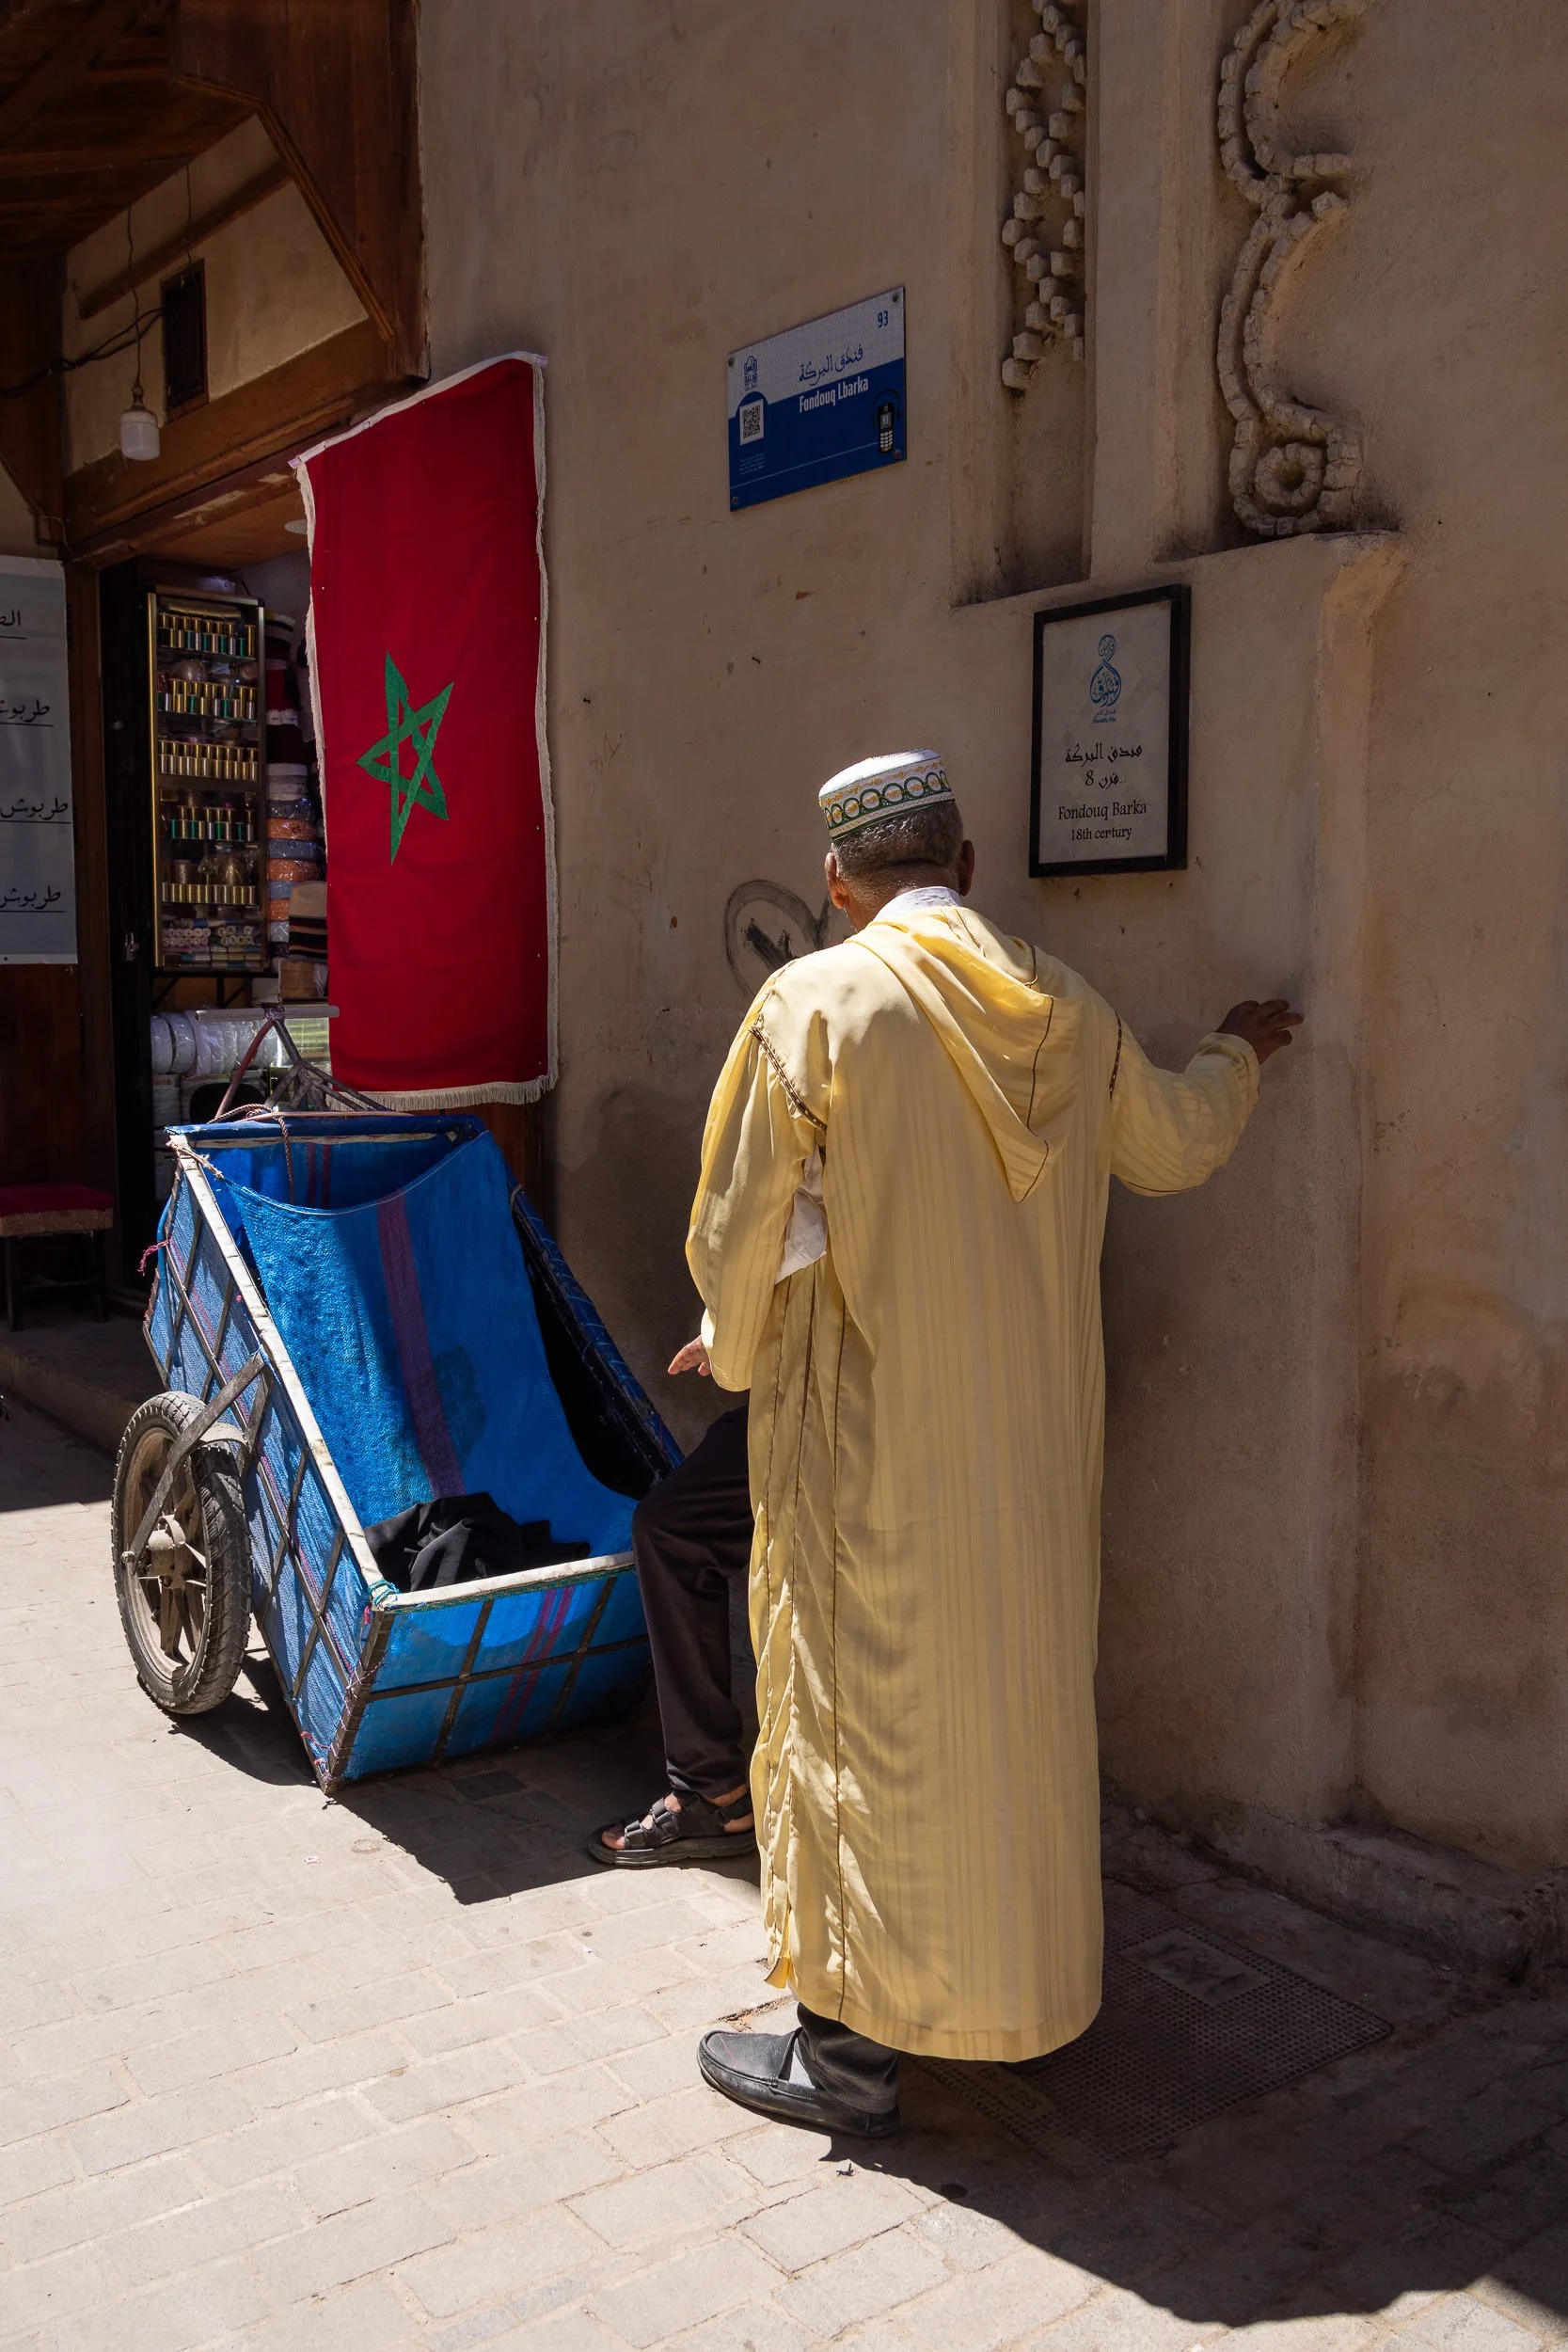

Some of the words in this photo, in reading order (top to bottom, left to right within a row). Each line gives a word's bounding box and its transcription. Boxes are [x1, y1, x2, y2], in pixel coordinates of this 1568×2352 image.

[878, 310, 889, 329] 93
[835, 343, 863, 373] فندق
[799, 355, 833, 387] البركة
[799, 389, 836, 414] Fondouq
[837, 375, 869, 401] Lbarka
[1085, 769, 1094, 787] 8
[0, 795, 69, 821] طربوش
[1057, 803, 1109, 821] Fondouq
[1111, 799, 1148, 817] Barka
[1070, 827, 1093, 841] 18th
